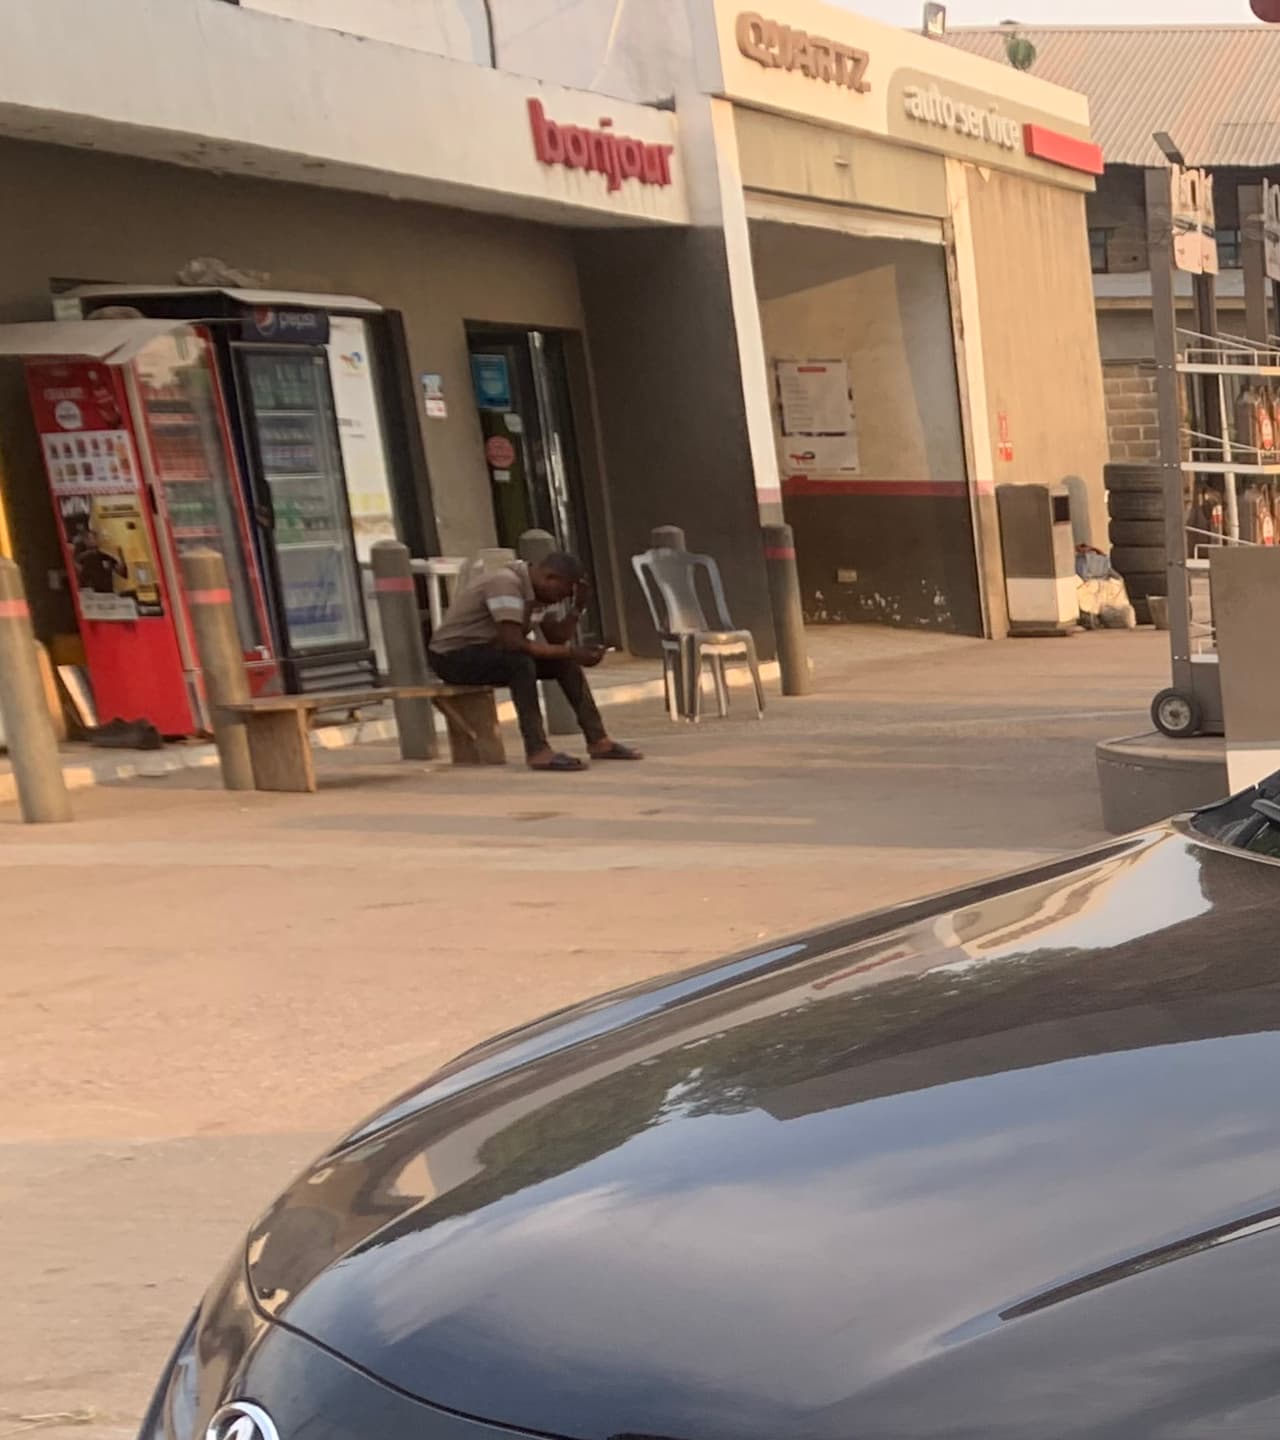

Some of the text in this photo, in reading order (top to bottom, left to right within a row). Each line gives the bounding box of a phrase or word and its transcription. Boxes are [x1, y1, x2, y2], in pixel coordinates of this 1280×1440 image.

[736, 12, 872, 94] QUARTZ
[527, 98, 674, 192] bonjour
[905, 84, 1021, 150] auto service
